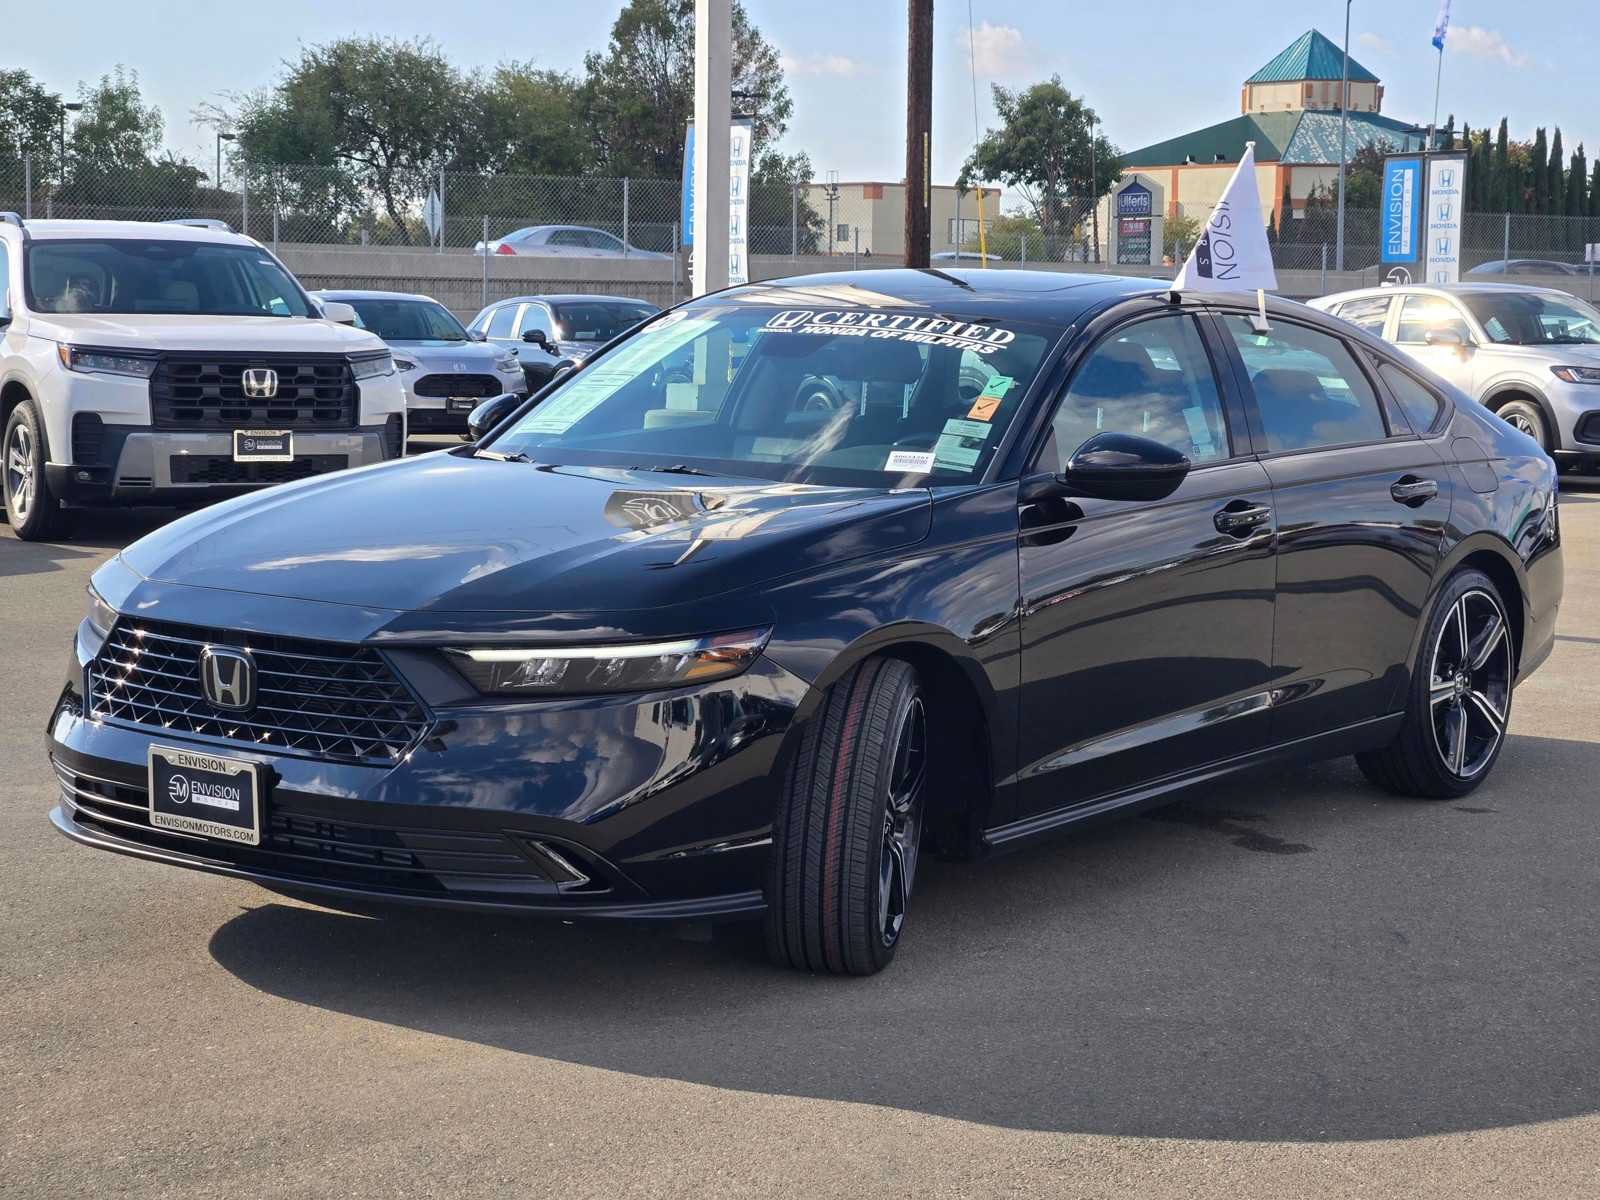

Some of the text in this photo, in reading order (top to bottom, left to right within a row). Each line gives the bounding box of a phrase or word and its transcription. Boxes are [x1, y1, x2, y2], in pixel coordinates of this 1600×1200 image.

[1431, 188, 1459, 196] HONDA
[1388, 169, 1404, 255] ENVISION
[1430, 222, 1458, 230] HONDA
[1429, 256, 1457, 264] HONDA
[811, 311, 1016, 345] CERTIFIED
[797, 326, 999, 354] HONDA OF MILPITAS
[178, 754, 226, 772] ENVISION
[191, 780, 240, 801] ENVISION
[154, 815, 254, 843] ENVISIONMOTORS.COM
